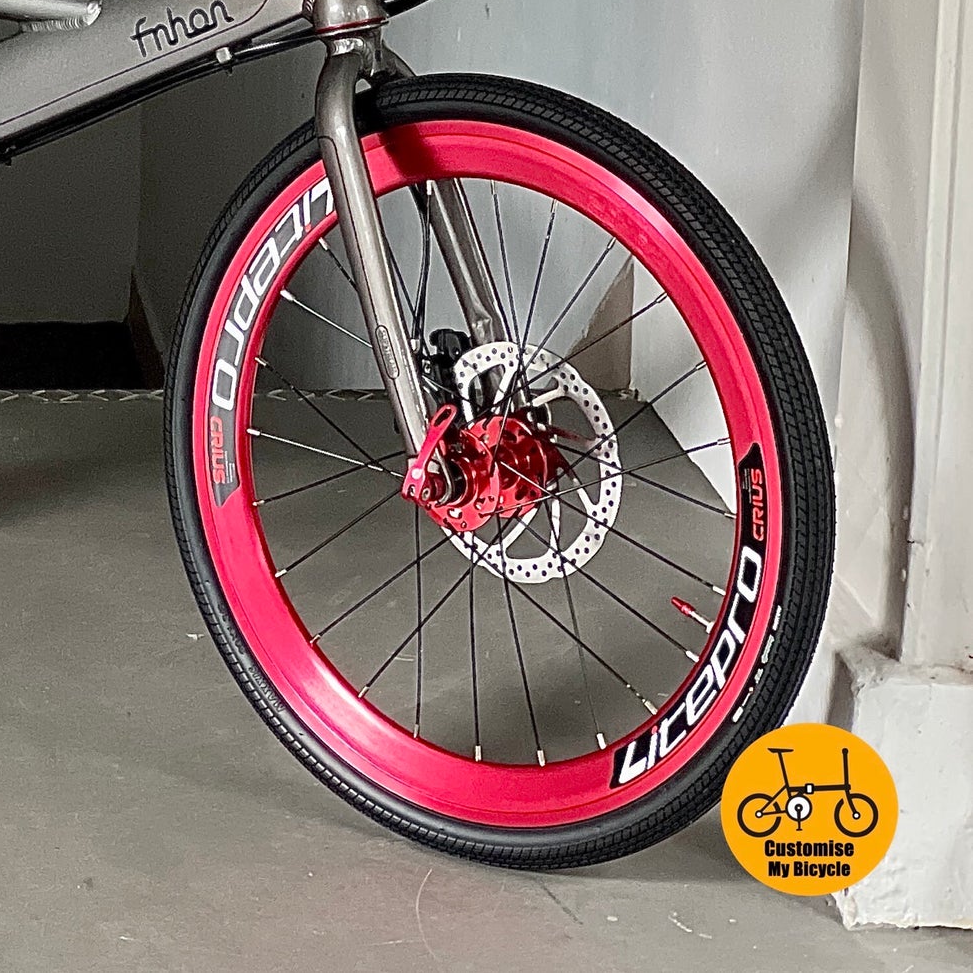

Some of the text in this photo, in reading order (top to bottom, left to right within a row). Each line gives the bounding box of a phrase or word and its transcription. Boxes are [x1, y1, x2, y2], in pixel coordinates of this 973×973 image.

[130, 0, 234, 58] fnhon
[210, 415, 226, 485] CRIUS
[750, 468, 765, 542] CRIUS
